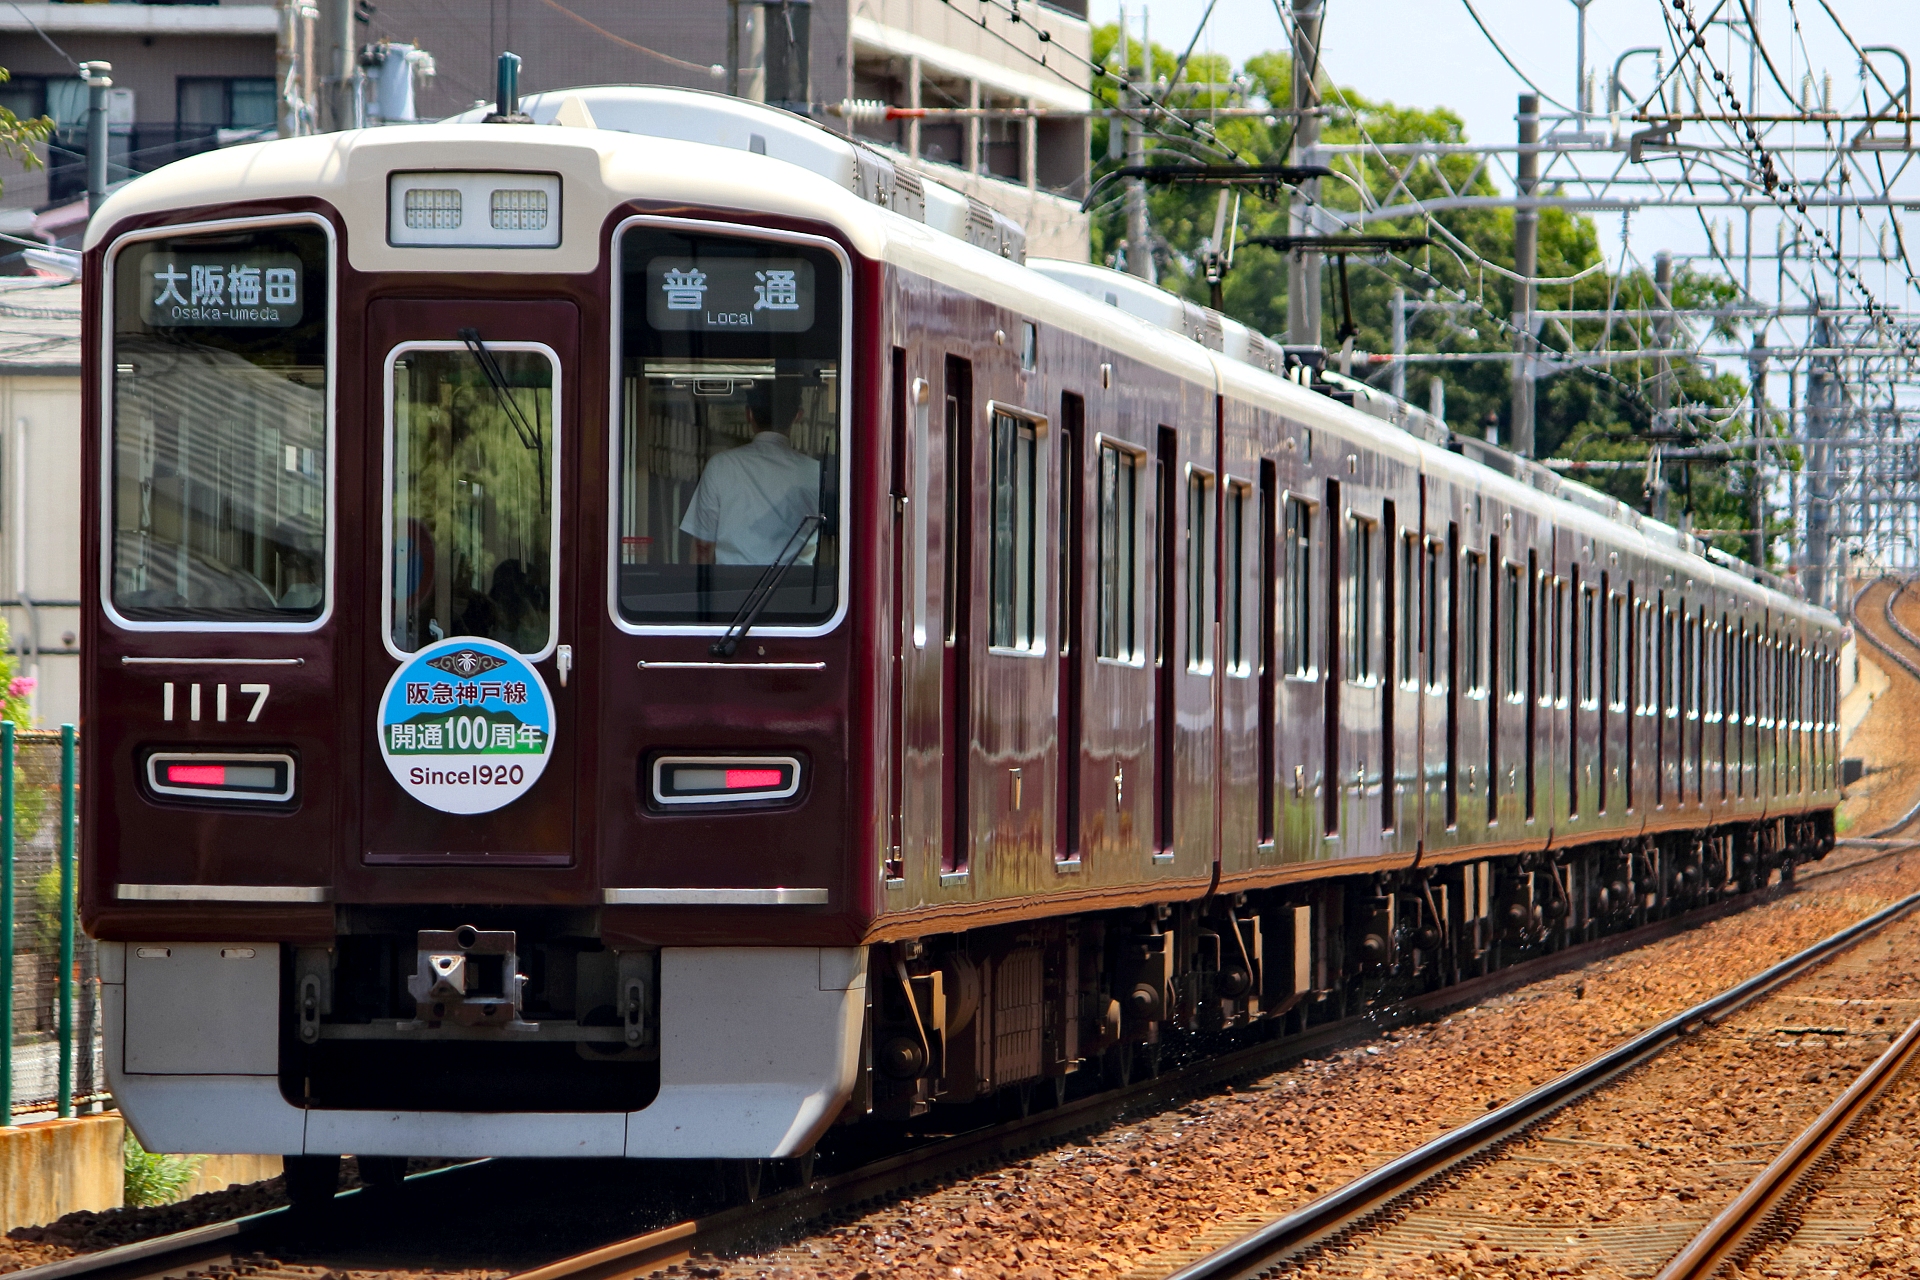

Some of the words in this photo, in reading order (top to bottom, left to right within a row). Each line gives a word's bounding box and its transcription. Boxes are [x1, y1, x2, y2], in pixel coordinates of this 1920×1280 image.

[154, 263, 297, 306] 大阪梅田
[171, 305, 280, 322] Osaka-umeda
[707, 311, 754, 325] Local
[163, 682, 271, 723] 1117
[406, 681, 528, 705] 阪急神戸線
[391, 715, 543, 750] 開通100周年
